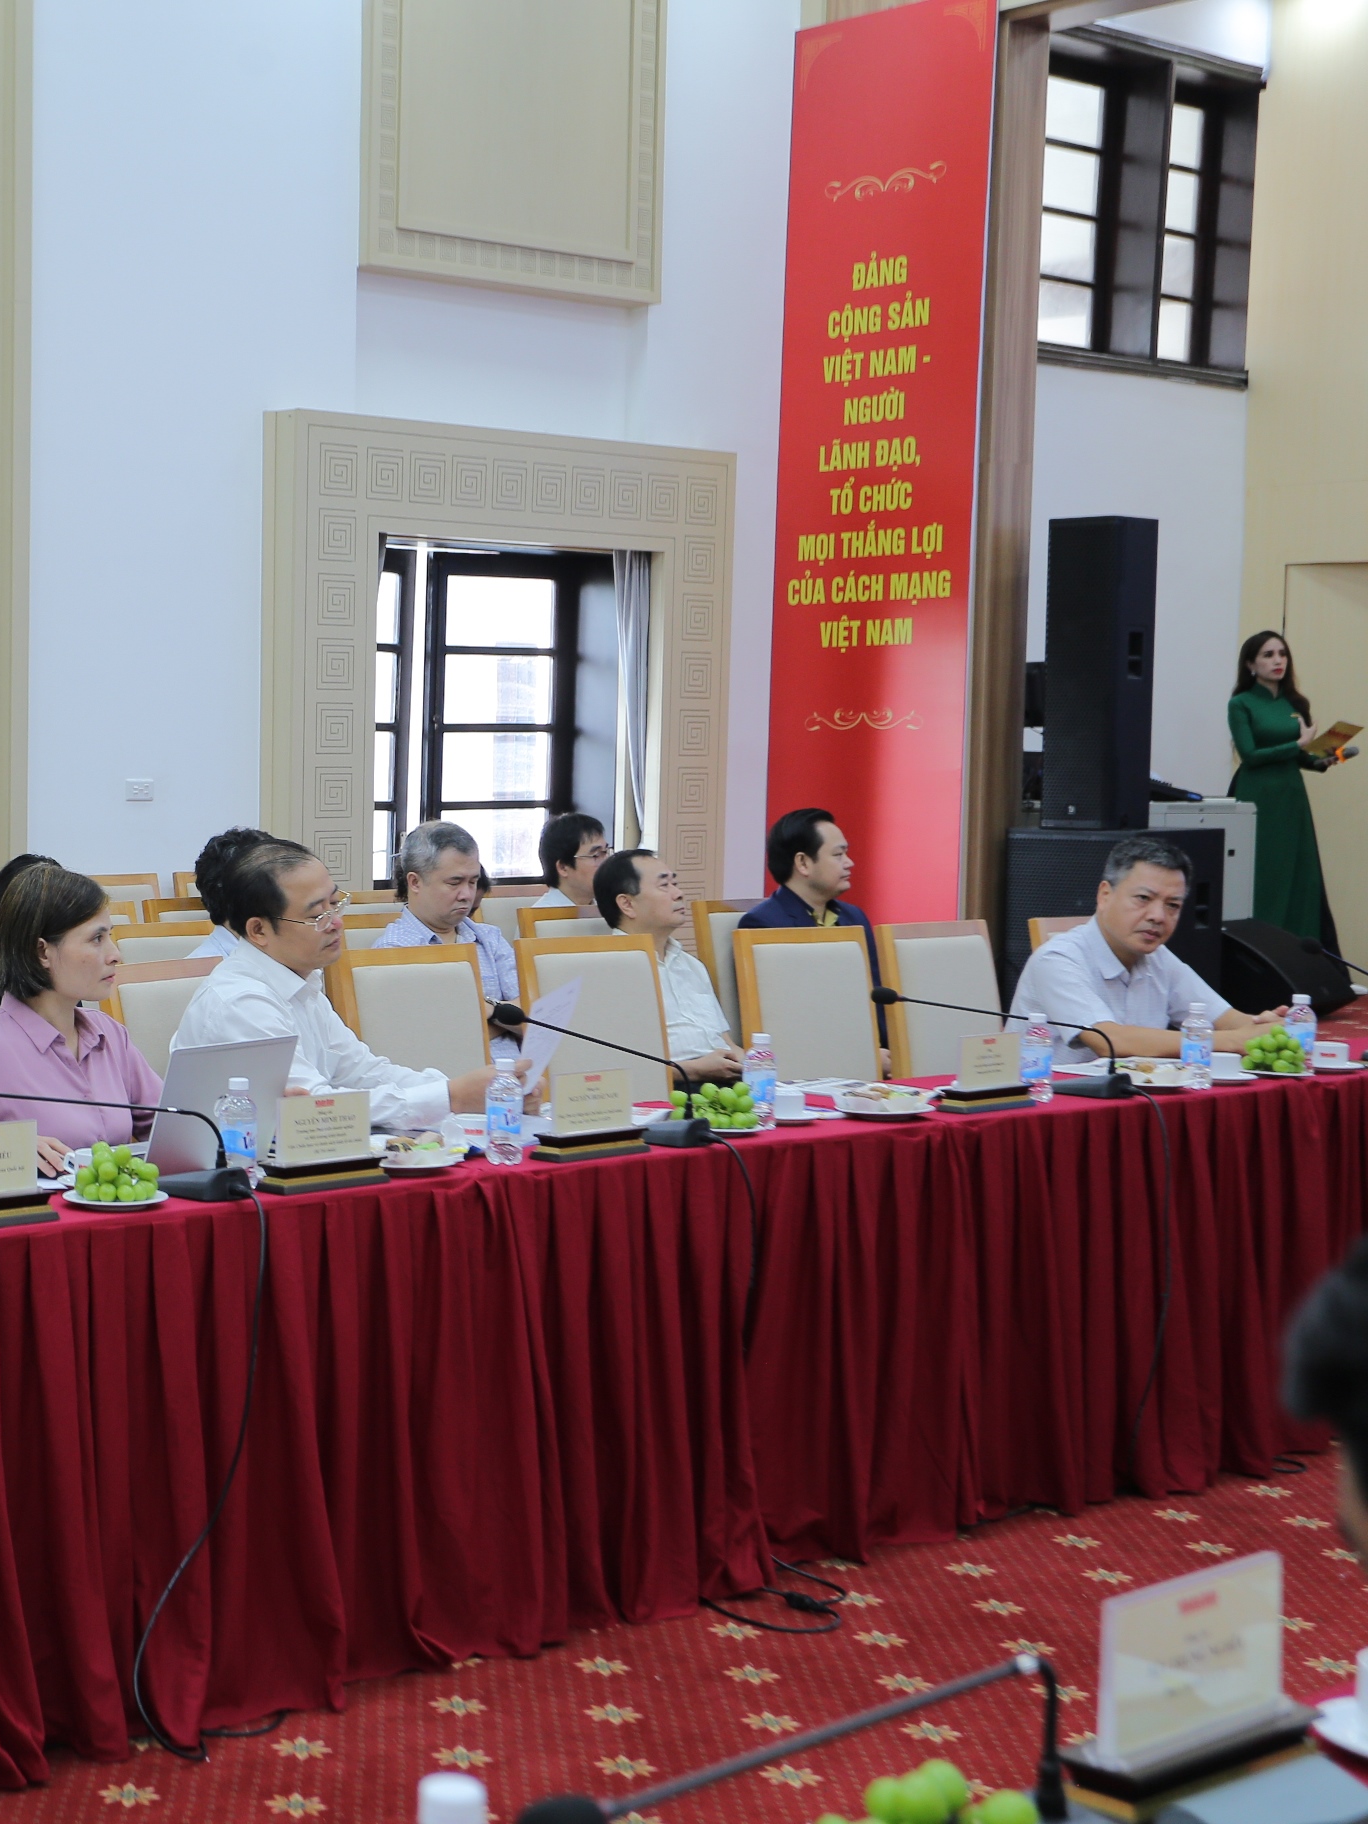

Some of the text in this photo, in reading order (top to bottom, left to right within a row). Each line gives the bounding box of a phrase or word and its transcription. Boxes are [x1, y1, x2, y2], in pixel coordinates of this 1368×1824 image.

[852, 250, 908, 292] ĐẢNG
[827, 290, 931, 343] CỘNG SẢN
[823, 347, 865, 387] VIỆT
[869, 344, 917, 379] NAM
[844, 386, 905, 426] NGƯỜI
[819, 435, 921, 473] LÃNH ĐẠO,
[829, 476, 913, 516] TỔ CHỨC
[798, 519, 944, 567] MỌI THẮNG LỢI
[787, 569, 952, 606] CỦA CÁCH MẠNG
[820, 614, 913, 654] VIỆT NAM
